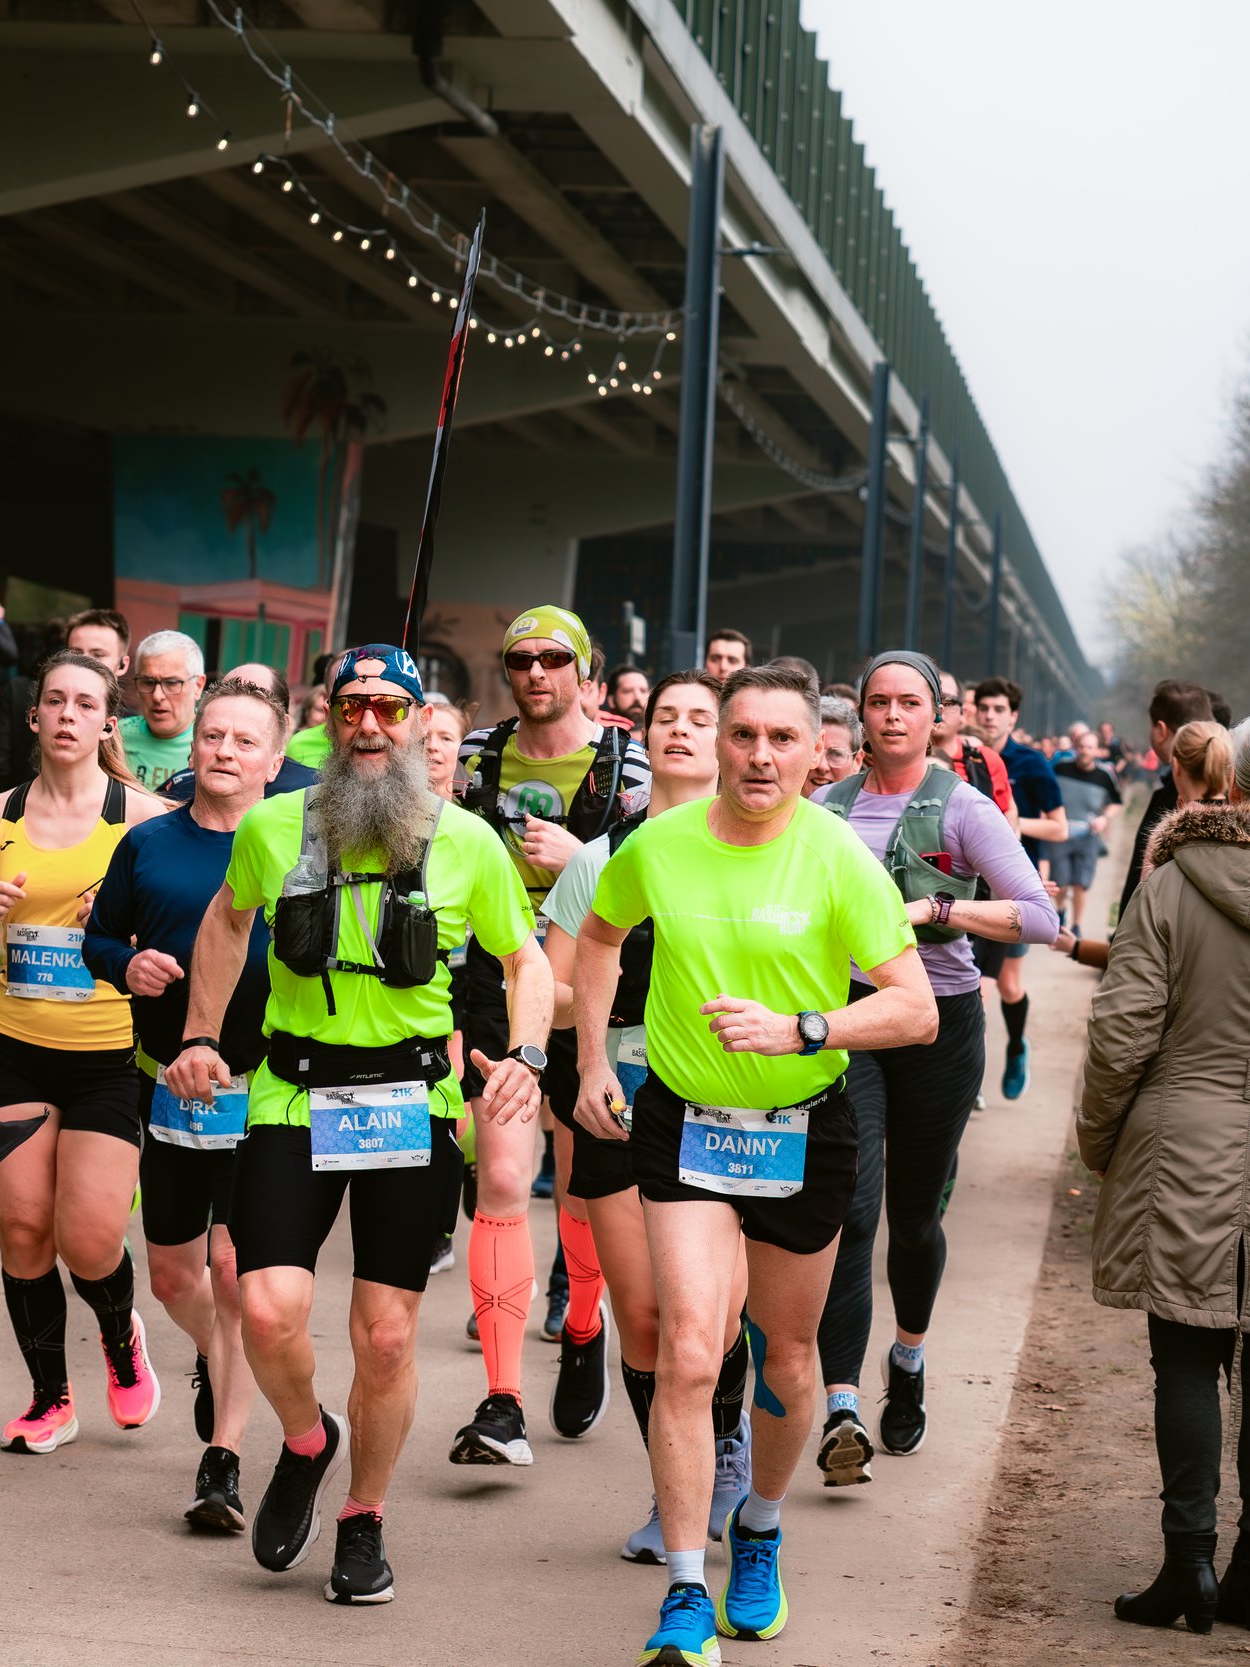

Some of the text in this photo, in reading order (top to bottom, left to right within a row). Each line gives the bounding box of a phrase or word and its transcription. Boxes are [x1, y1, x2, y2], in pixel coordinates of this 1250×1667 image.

[37, 972, 53, 982] 778
[391, 1088, 413, 1098] 21K
[338, 1111, 402, 1131] ALAIN
[358, 1138, 384, 1149] 3807
[705, 1132, 782, 1156] DANNY
[727, 1162, 754, 1175] 3811
